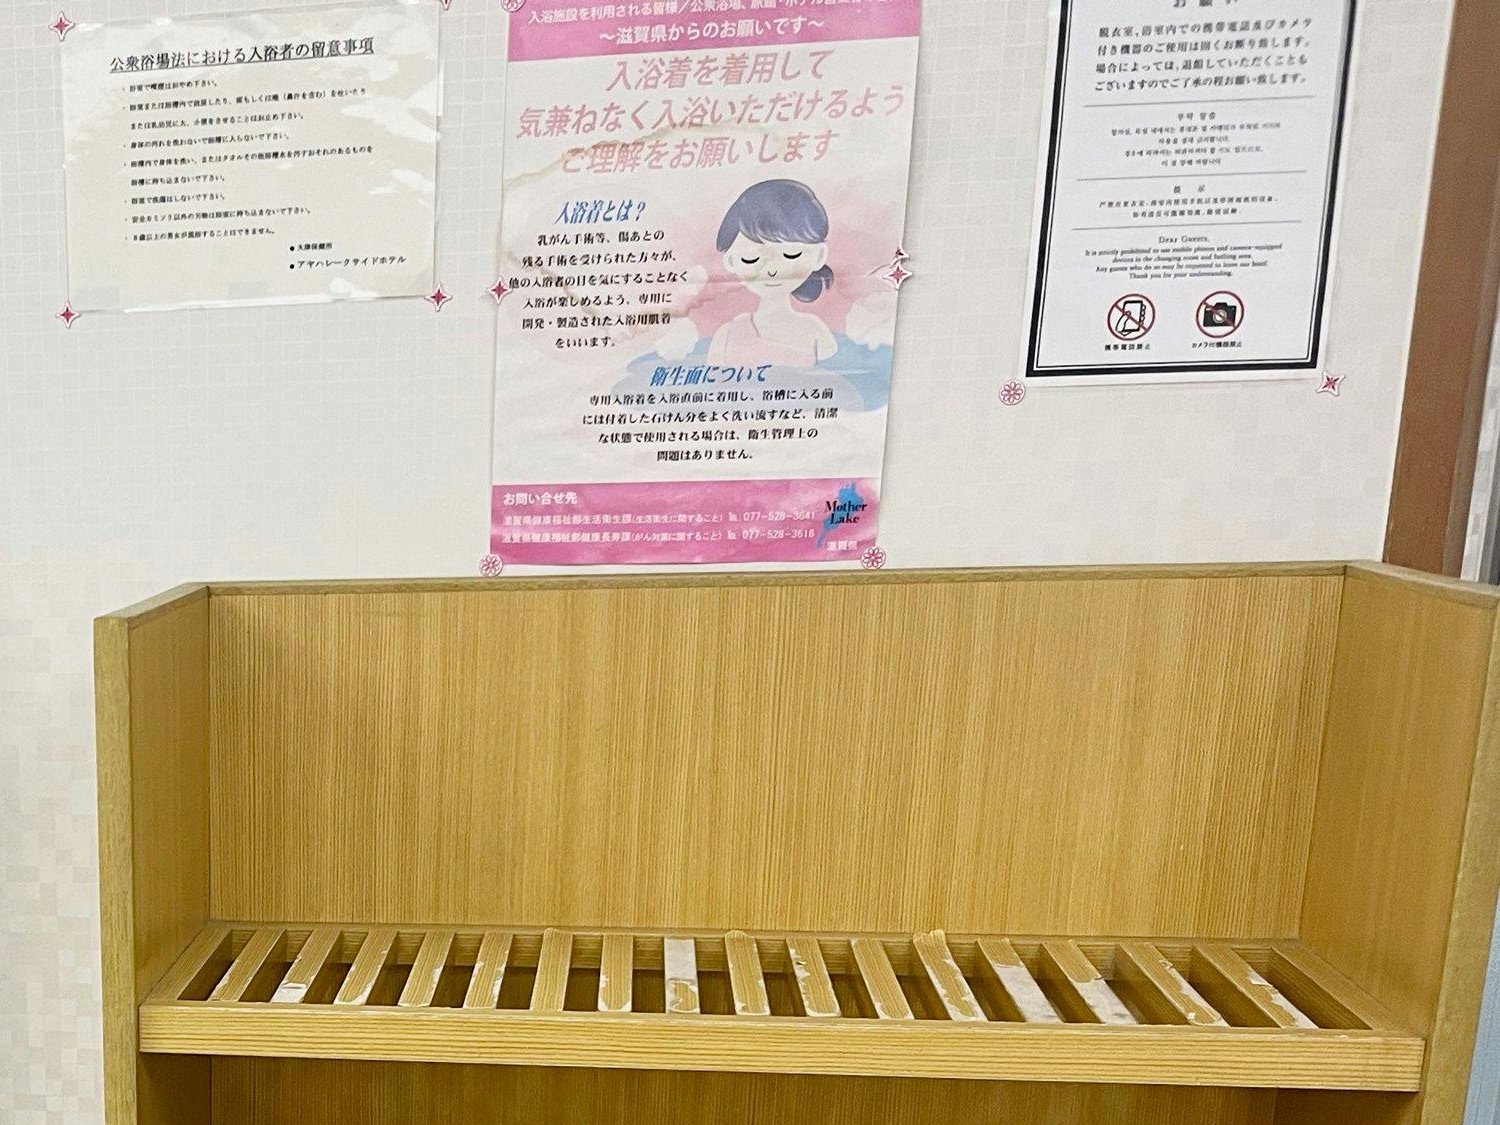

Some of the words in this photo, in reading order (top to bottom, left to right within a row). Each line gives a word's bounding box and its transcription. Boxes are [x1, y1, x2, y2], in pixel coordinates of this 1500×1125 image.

[109, 37, 374, 72] 公衆浴場法における入浴者の留意事項
[606, 48, 837, 93] 入浴着を着用して
[516, 84, 908, 139] 気兼ねなく入浴いただけるよう
[560, 129, 840, 175] ご理解をお願いします
[554, 200, 646, 224] 入浴着とは？
[509, 271, 688, 289] 他の入浴者の目を気にすることなく
[650, 364, 772, 387] 衛生面について
[657, 449, 754, 461] 問題はありません。
[503, 491, 577, 505] お問い合せ先
[824, 500, 867, 513] Mother
[830, 512, 860, 525] Lake
